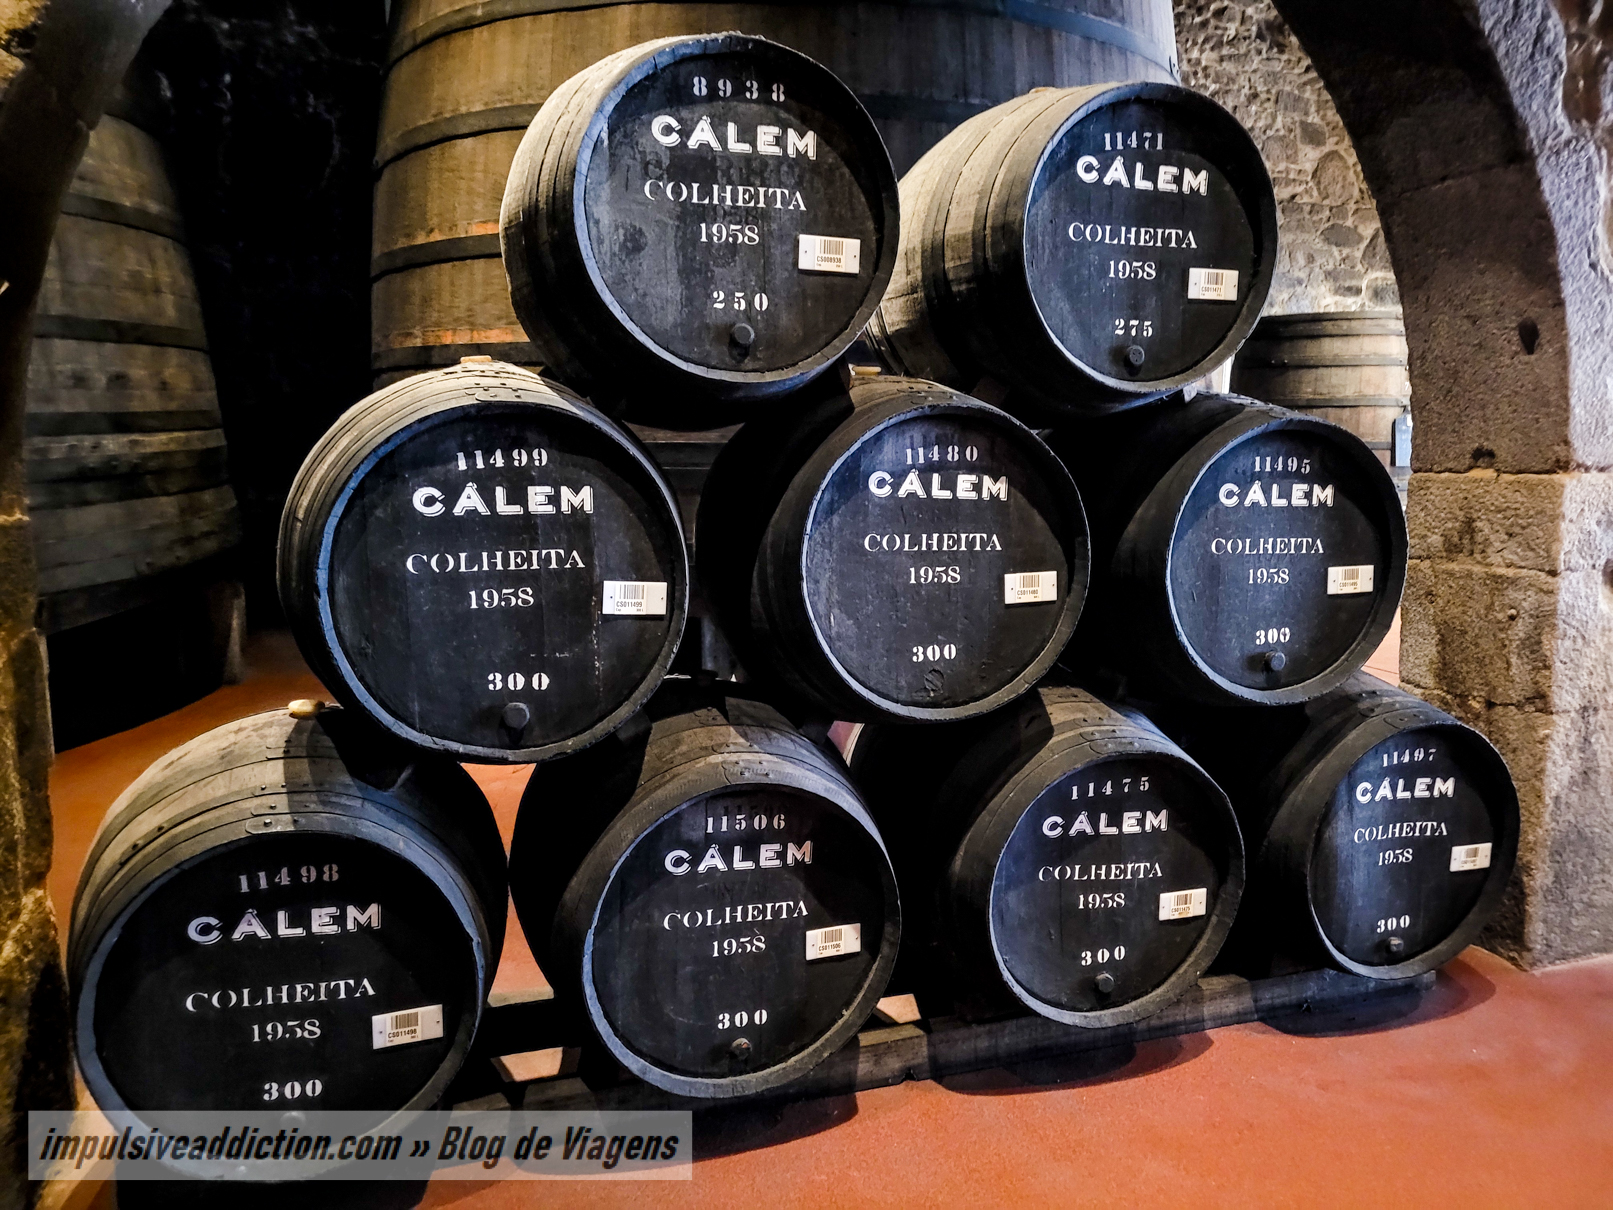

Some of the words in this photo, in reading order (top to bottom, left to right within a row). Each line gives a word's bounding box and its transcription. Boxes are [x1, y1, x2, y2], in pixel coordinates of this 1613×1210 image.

[693, 77, 785, 106] 8938
[1105, 131, 1162, 150] 11471
[644, 180, 806, 210] COLHEITA
[700, 223, 759, 244] 1958
[1069, 222, 1197, 248] COLHEITA
[1109, 260, 1156, 279] 1958
[713, 291, 768, 311] 250
[1115, 319, 1152, 337] 275
[457, 449, 547, 470] 11499
[906, 444, 977, 464] 11480
[1255, 456, 1310, 473] 11495
[864, 533, 1001, 551] COLHEITA
[1212, 538, 1323, 554] COLHEITA
[406, 549, 585, 574] COLHEITA
[910, 566, 960, 583] 1958
[1249, 568, 1289, 583] 1958
[469, 588, 534, 608] 1958
[616, 600, 643, 608] CS011499
[1256, 628, 1290, 644] 300
[913, 644, 956, 662] 300
[488, 673, 549, 690] 300
[1383, 748, 1435, 767] 11497
[1072, 777, 1148, 799] 11475
[707, 815, 785, 833] 11506
[1354, 822, 1447, 843] COLHEITA
[1379, 849, 1412, 865] 1958
[240, 865, 338, 892] 11498
[1039, 863, 1162, 880] COLHEITA
[1079, 893, 1124, 908] 1958
[664, 901, 808, 930] COLHEITA
[1377, 915, 1409, 932] 300
[713, 936, 765, 957] 1958
[1082, 946, 1125, 965] 300
[186, 978, 375, 1011] COLHEITA
[718, 1010, 767, 1029] 300
[253, 1020, 320, 1041] 1958
[387, 1028, 418, 1039] CS011498
[264, 1080, 322, 1100] 300
